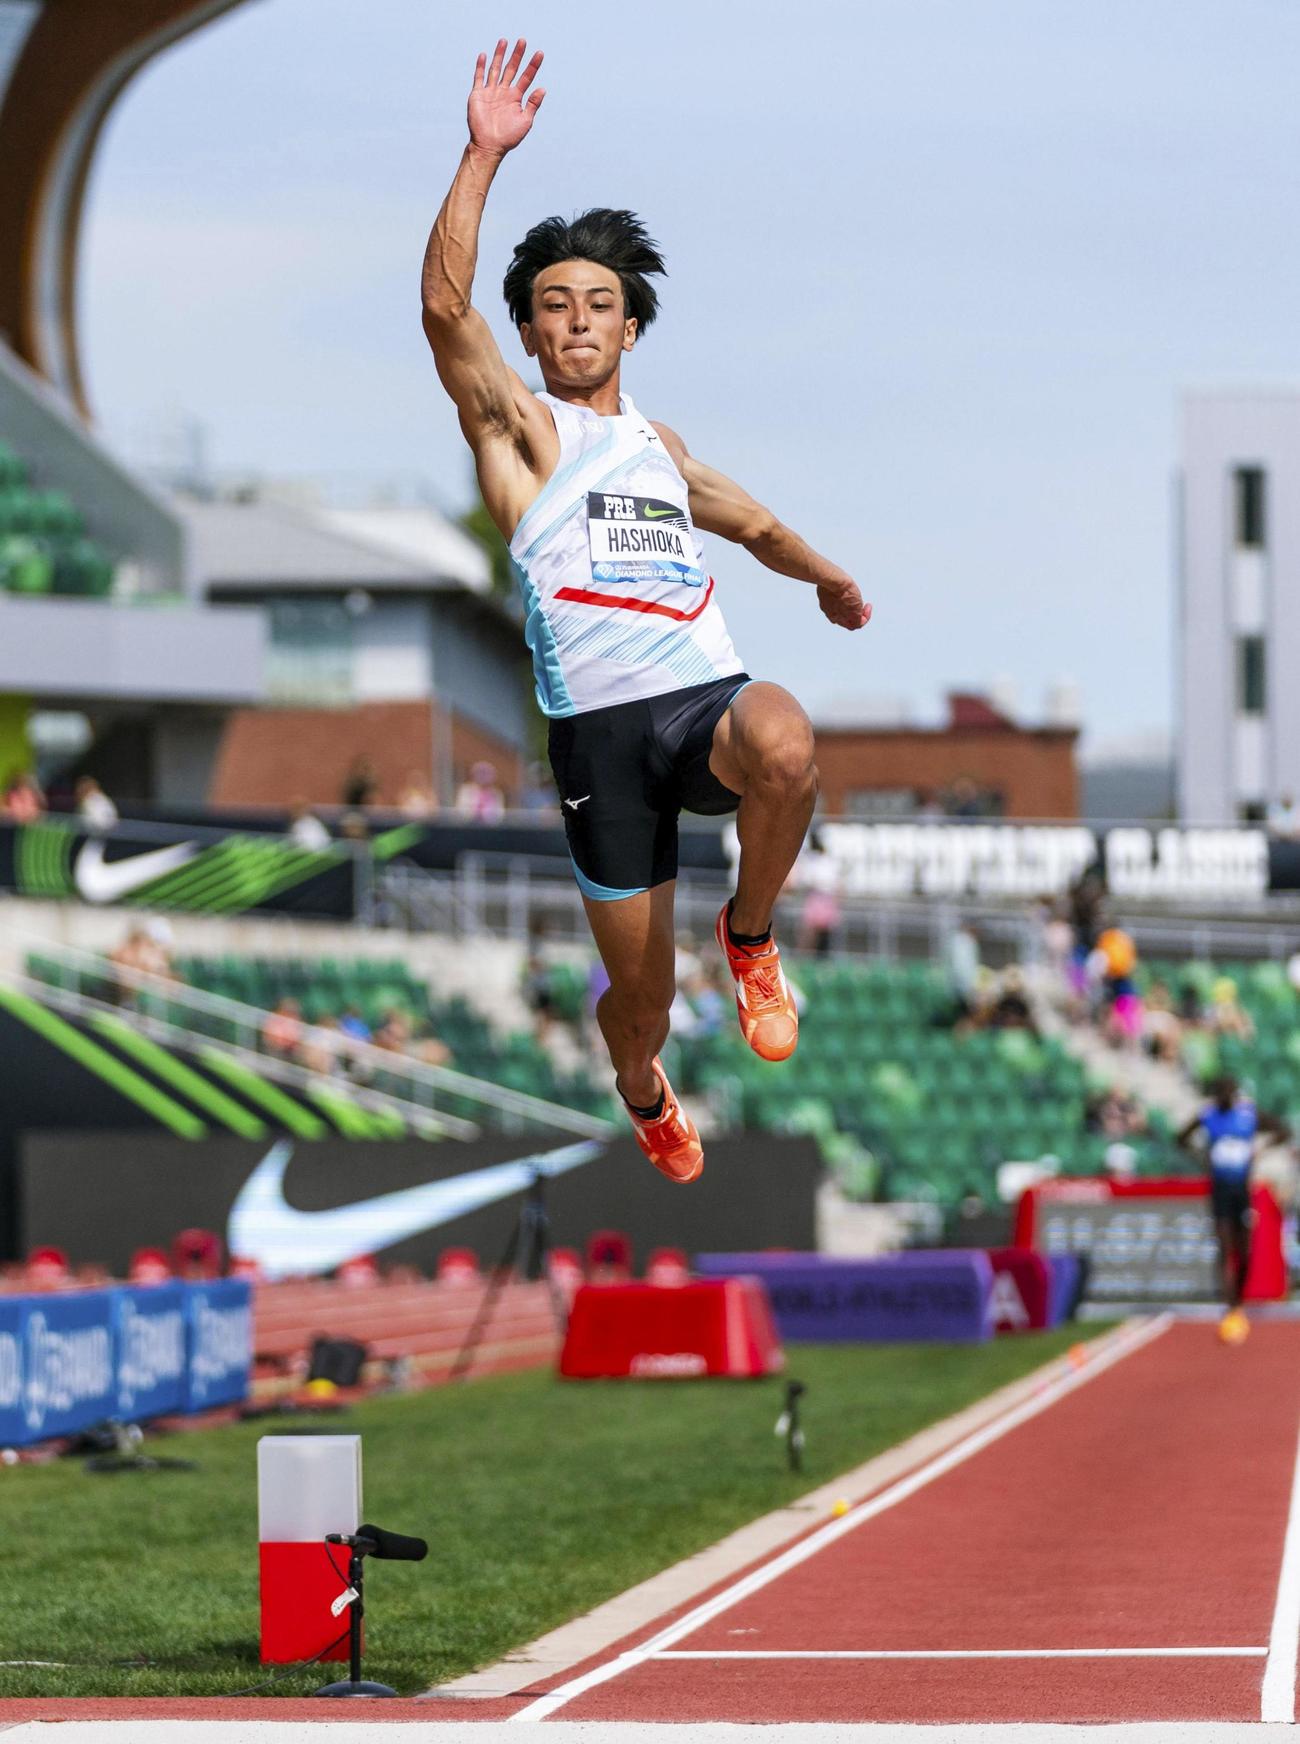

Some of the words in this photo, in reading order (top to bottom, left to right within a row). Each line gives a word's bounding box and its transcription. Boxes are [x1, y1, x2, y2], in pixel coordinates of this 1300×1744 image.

[603, 495, 637, 520] PRE
[607, 527, 685, 558] HASHIOKA
[615, 569, 653, 578] DIAMOND
[654, 569, 683, 578] LEAGUE
